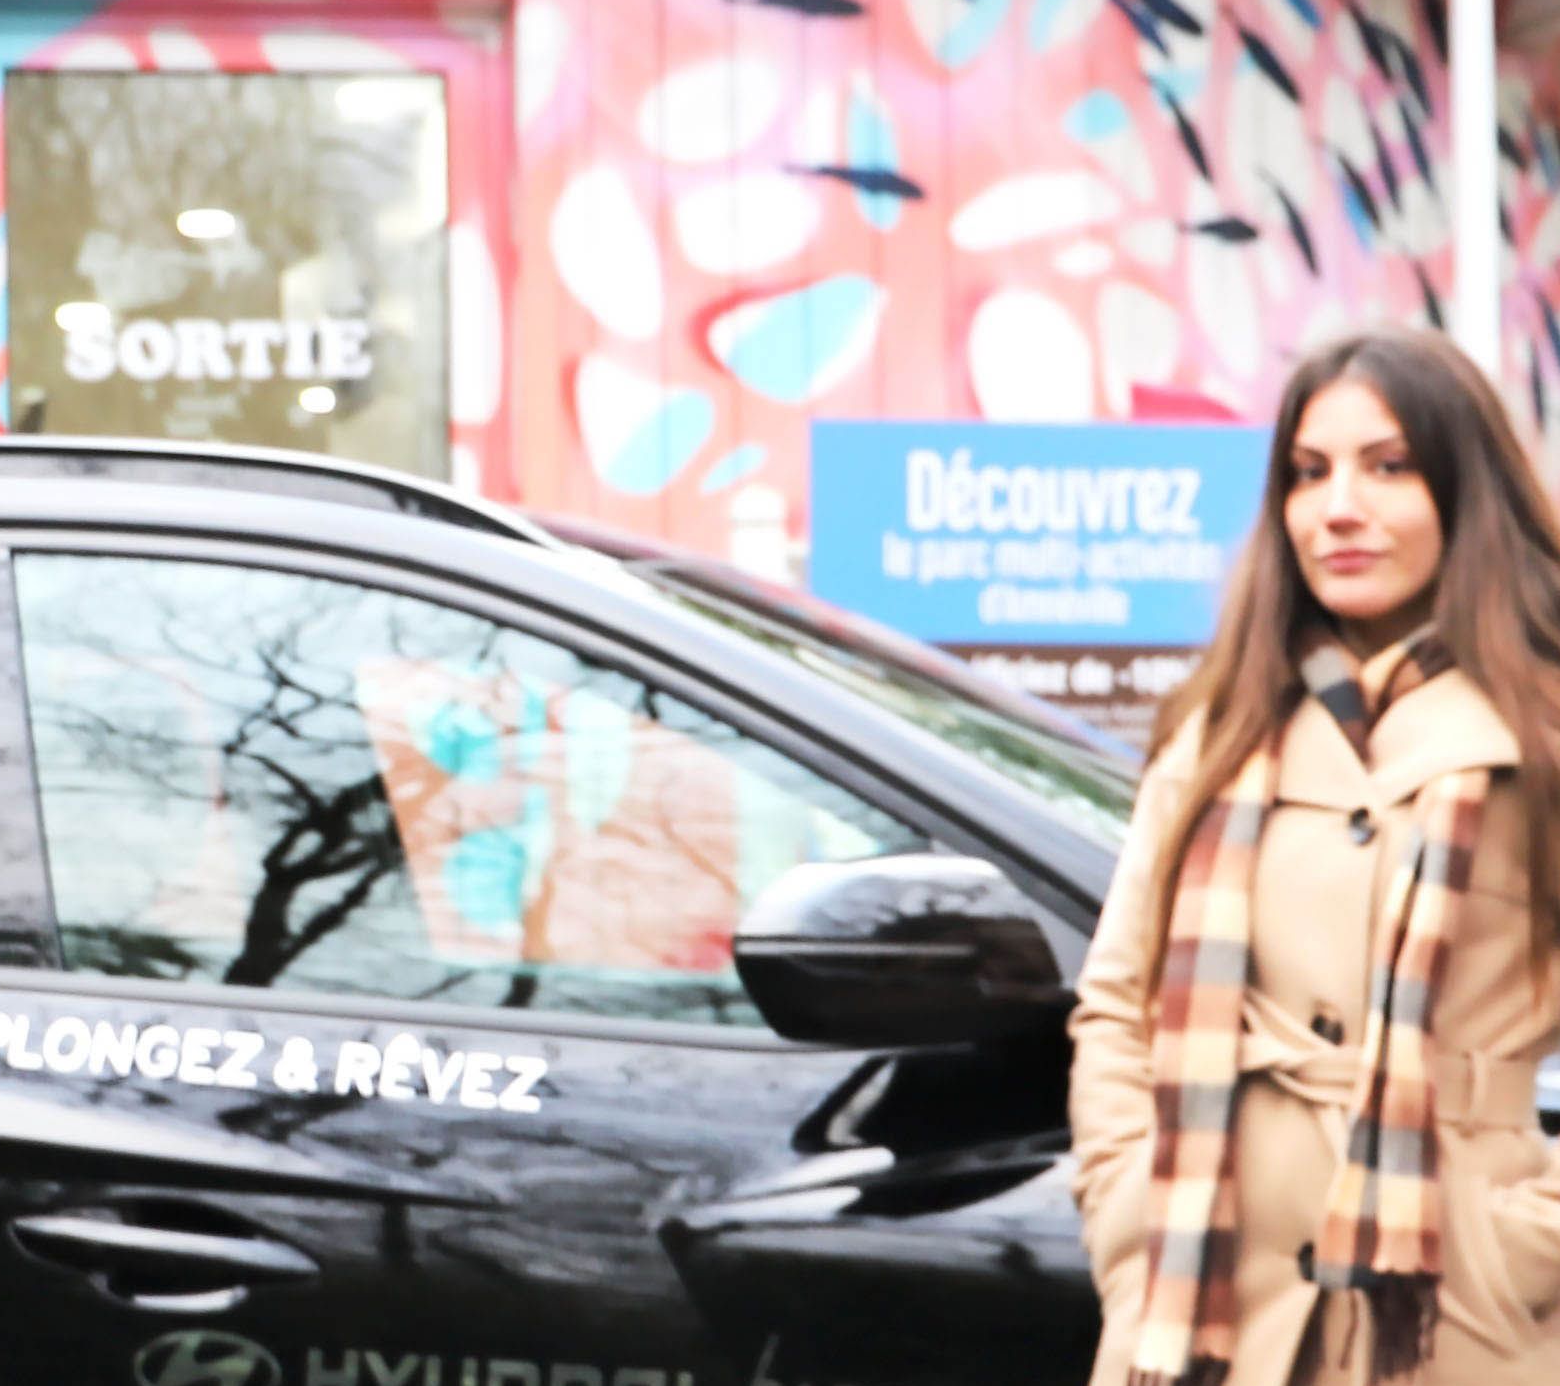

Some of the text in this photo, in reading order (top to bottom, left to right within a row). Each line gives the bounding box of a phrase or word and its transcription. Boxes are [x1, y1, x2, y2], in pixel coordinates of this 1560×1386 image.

[63, 317, 374, 382] SORTIE
[905, 448, 1201, 534] Découvrez
[272, 1038, 319, 1094] &
[334, 1030, 551, 1115] RÊVEZ
